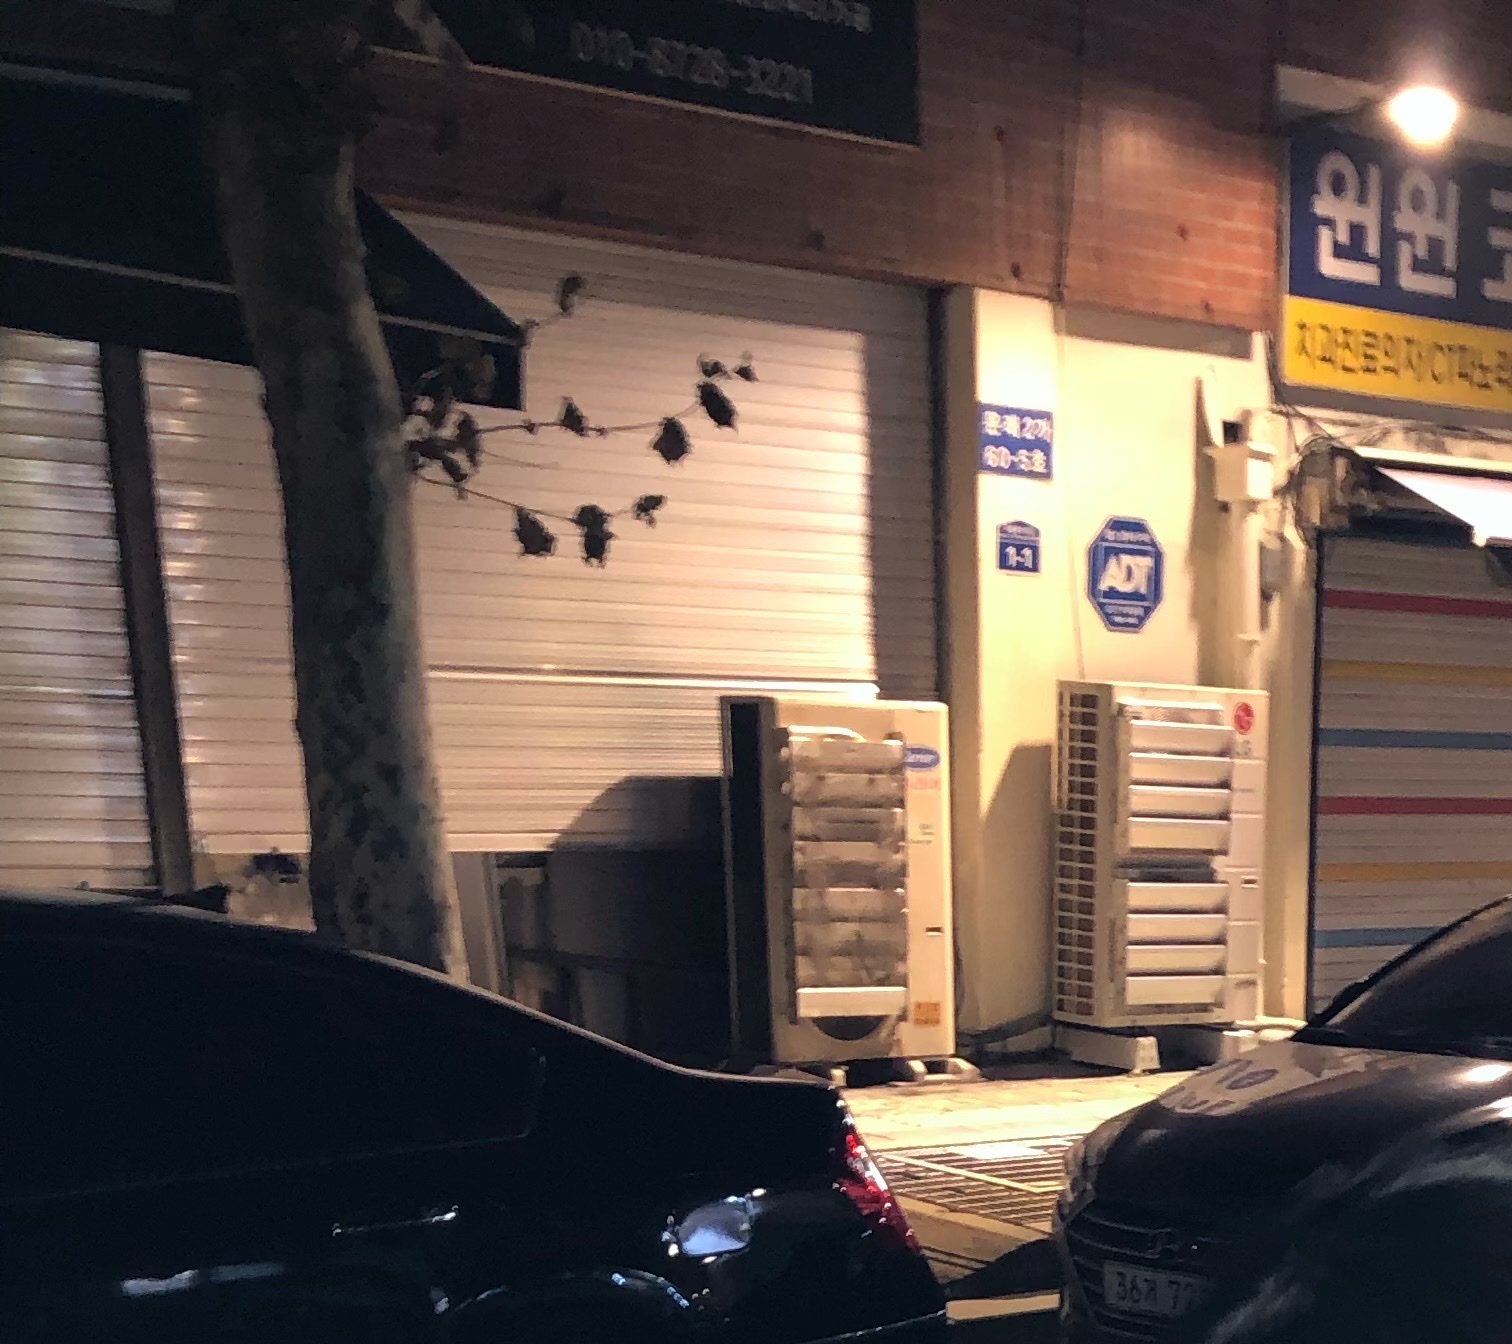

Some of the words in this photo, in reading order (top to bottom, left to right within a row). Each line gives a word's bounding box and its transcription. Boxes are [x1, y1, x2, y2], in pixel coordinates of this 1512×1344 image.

[1310, 150, 1460, 300] 원원
[1004, 545, 1033, 569] 1-1
[1098, 553, 1154, 594] ADT
